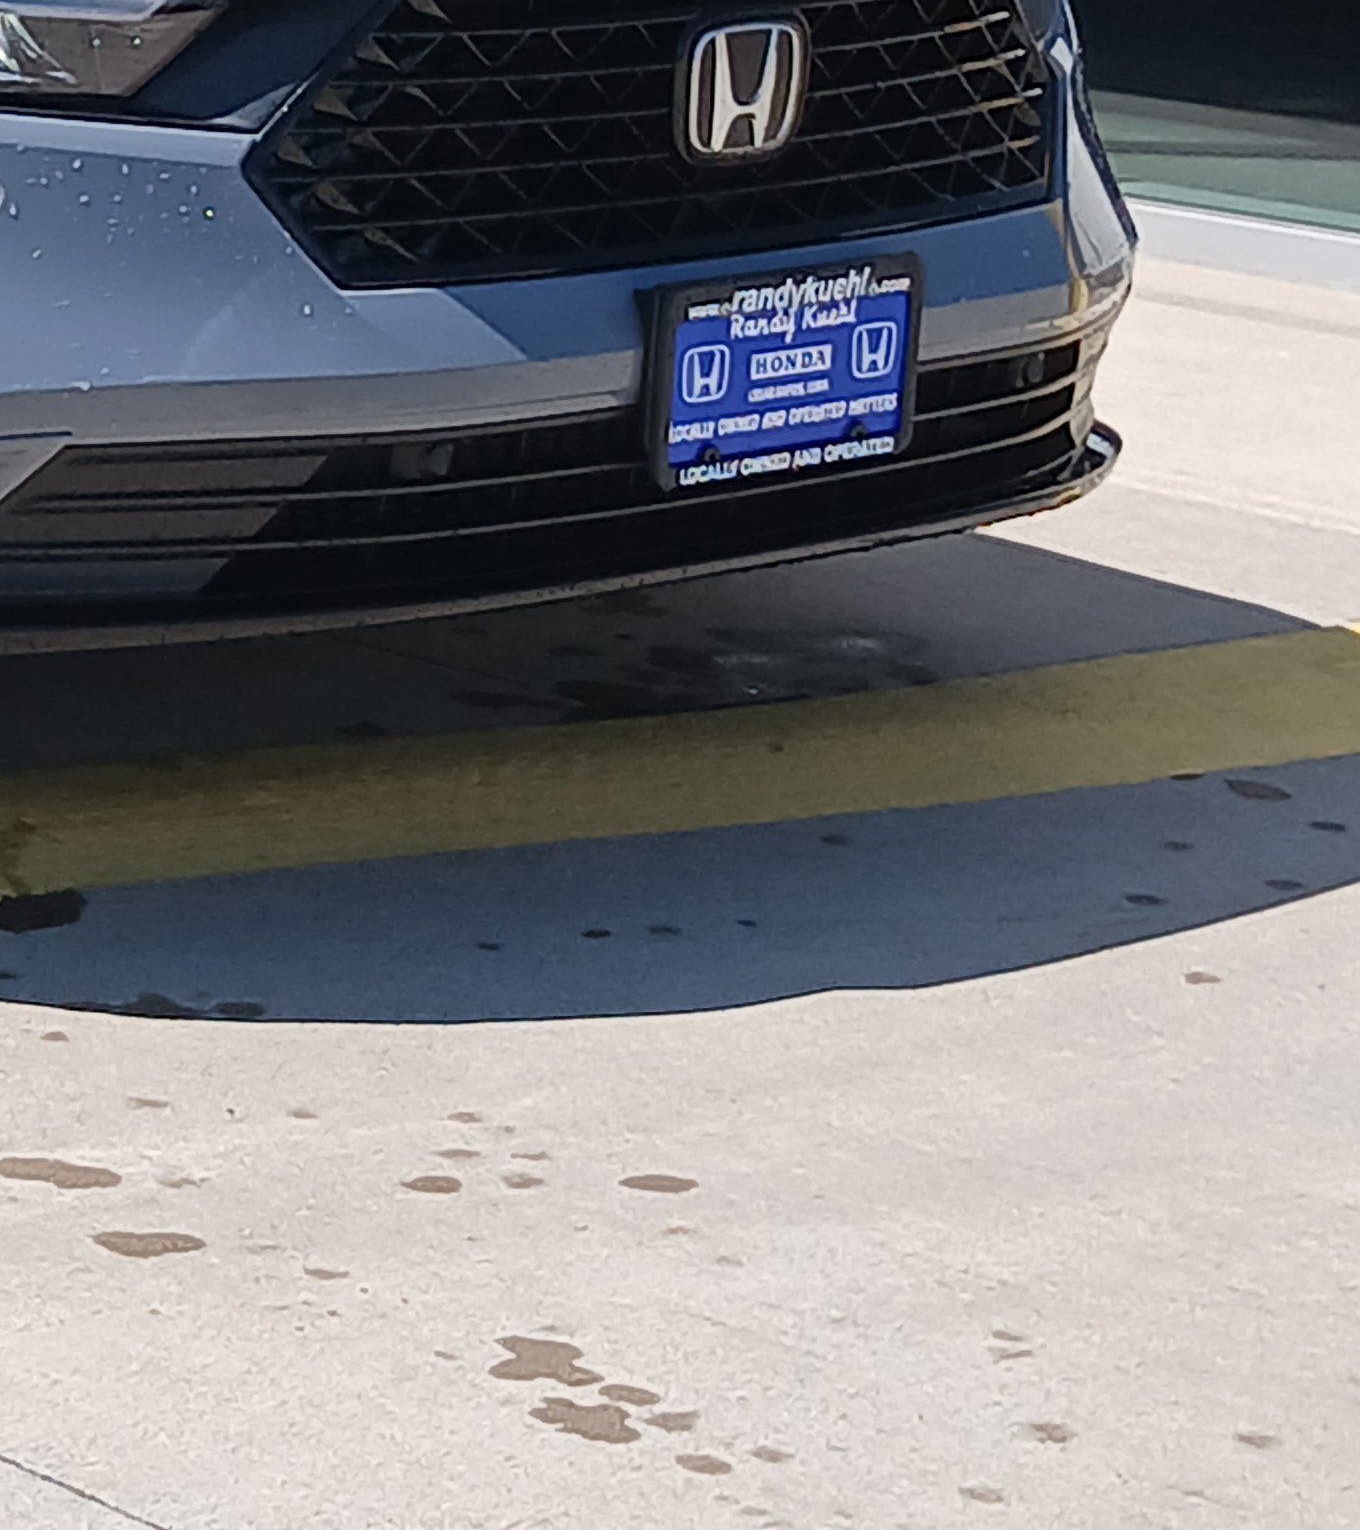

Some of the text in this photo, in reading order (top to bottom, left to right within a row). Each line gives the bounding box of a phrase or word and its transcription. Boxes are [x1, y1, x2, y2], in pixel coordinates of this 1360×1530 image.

[730, 314, 795, 343] Randy
[755, 350, 826, 375] HONDA
[680, 460, 739, 485] LOCALLY
